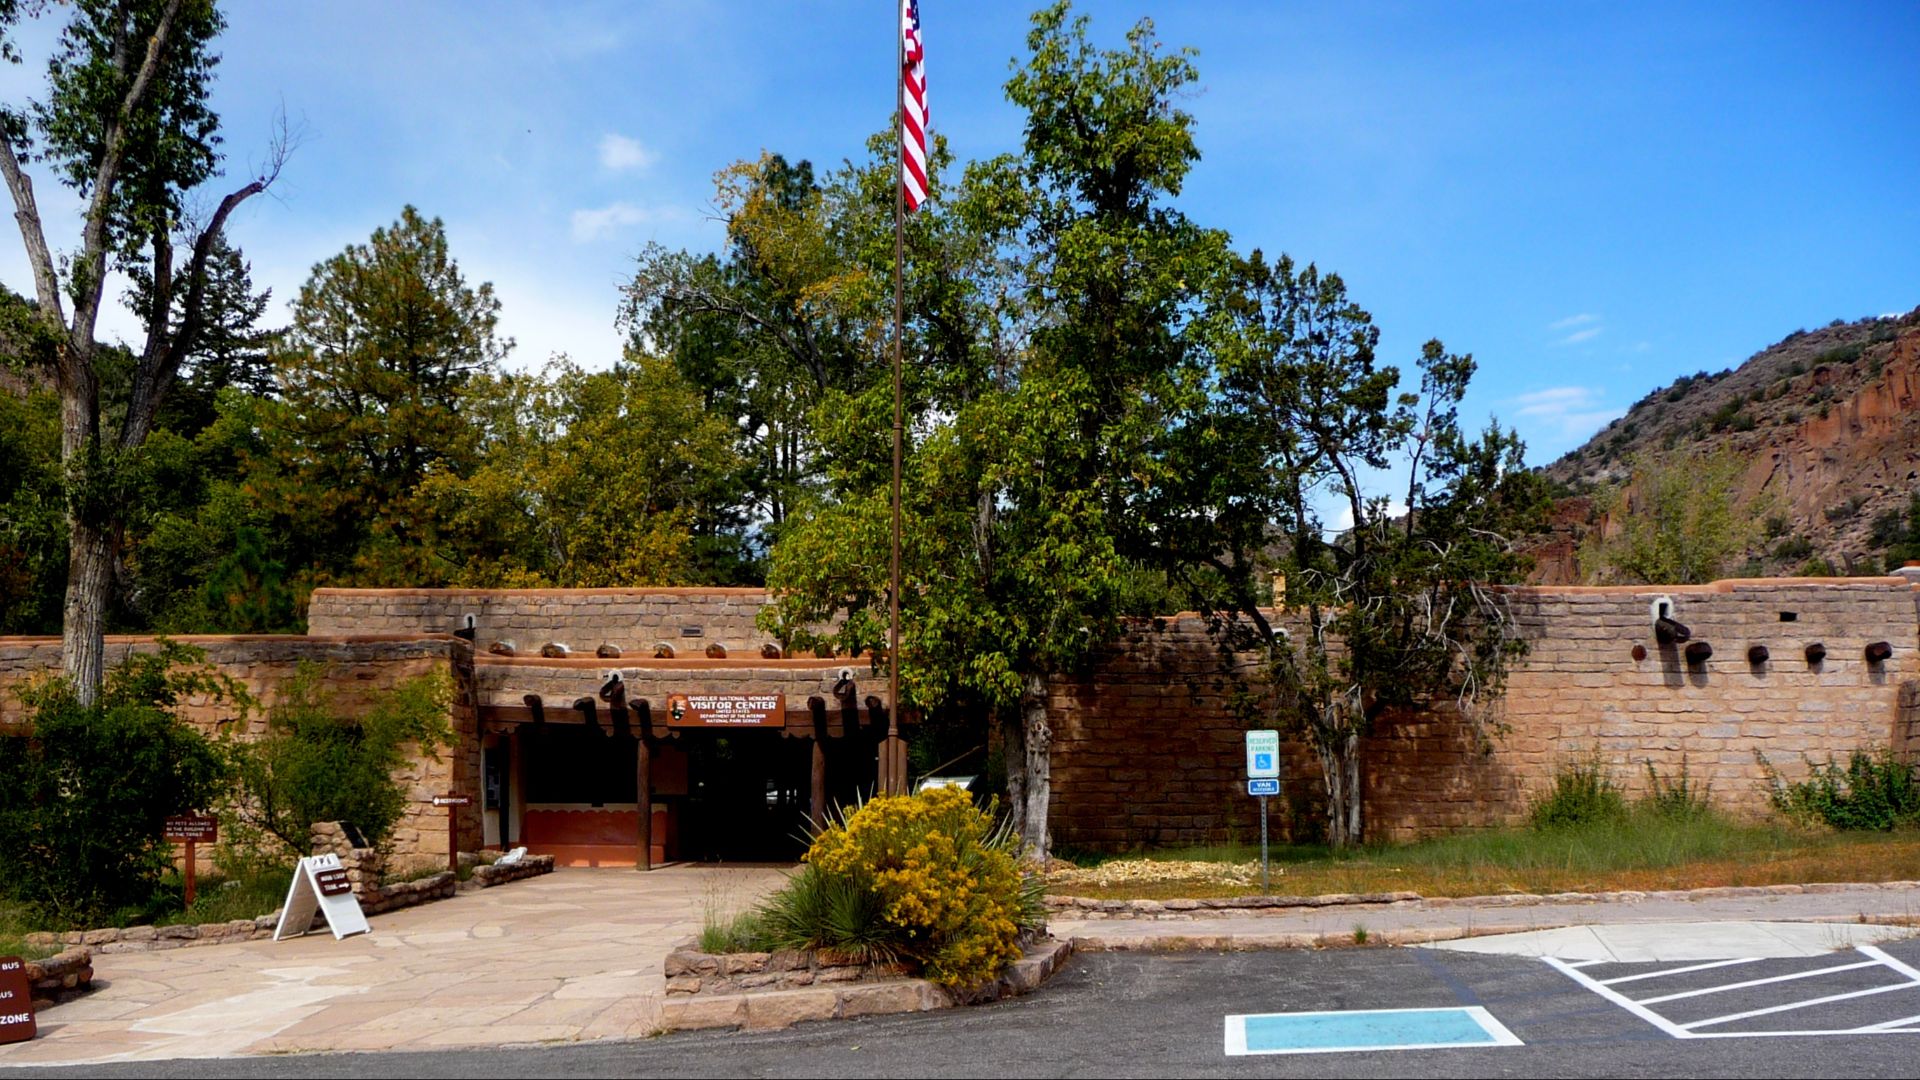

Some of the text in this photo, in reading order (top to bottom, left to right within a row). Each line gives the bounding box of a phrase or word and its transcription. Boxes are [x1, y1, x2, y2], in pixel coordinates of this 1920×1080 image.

[690, 701, 776, 709] VISITOR CENTER
[2, 962, 20, 970] BUS
[0, 1013, 30, 1025] ZONE
